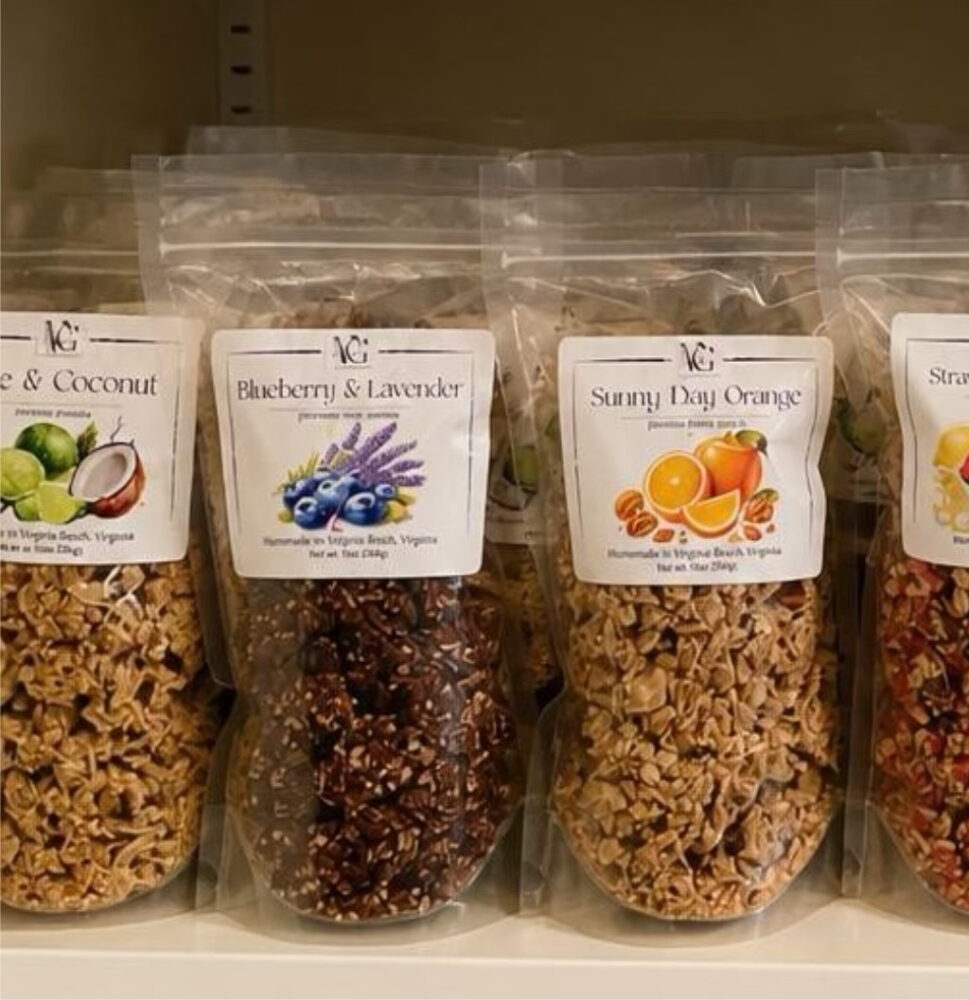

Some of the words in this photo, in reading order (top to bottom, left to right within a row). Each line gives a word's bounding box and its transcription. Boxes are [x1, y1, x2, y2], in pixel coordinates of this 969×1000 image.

[23, 369, 42, 391] &
[53, 369, 158, 396] Coconut
[237, 377, 336, 405] Blueberry
[343, 378, 361, 400] &
[368, 377, 463, 400] Lavender
[590, 386, 661, 413] Sunny
[670, 385, 716, 412] Day
[724, 385, 802, 411] Orange
